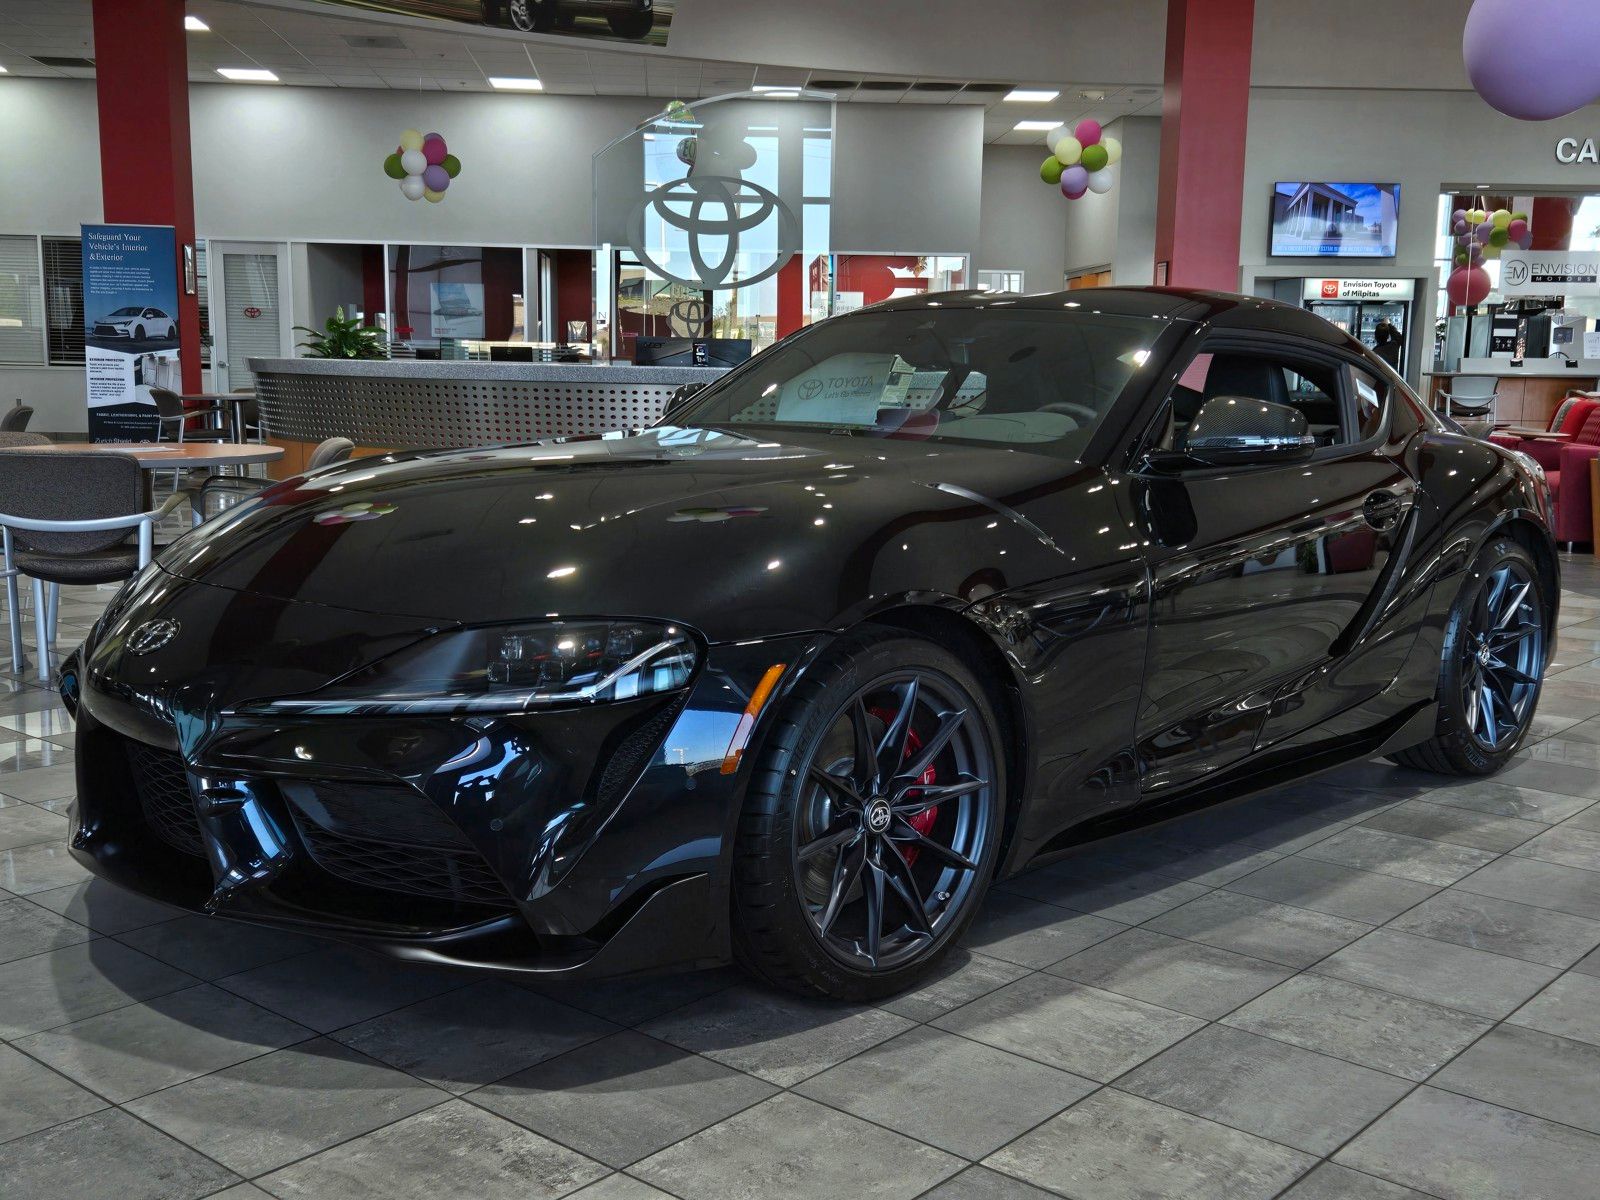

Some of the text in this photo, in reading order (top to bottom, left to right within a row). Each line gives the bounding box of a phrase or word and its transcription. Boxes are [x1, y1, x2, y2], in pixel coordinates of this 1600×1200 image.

[1555, 137, 1600, 164] CA
[88, 232, 141, 241] Safeguard Your
[89, 242, 148, 252] Vehicle's Interior
[1531, 263, 1599, 275] ENVISION
[1374, 281, 1397, 289] Toyota
[1351, 290, 1380, 298] Milpitas
[828, 376, 874, 389] TOYOTA
